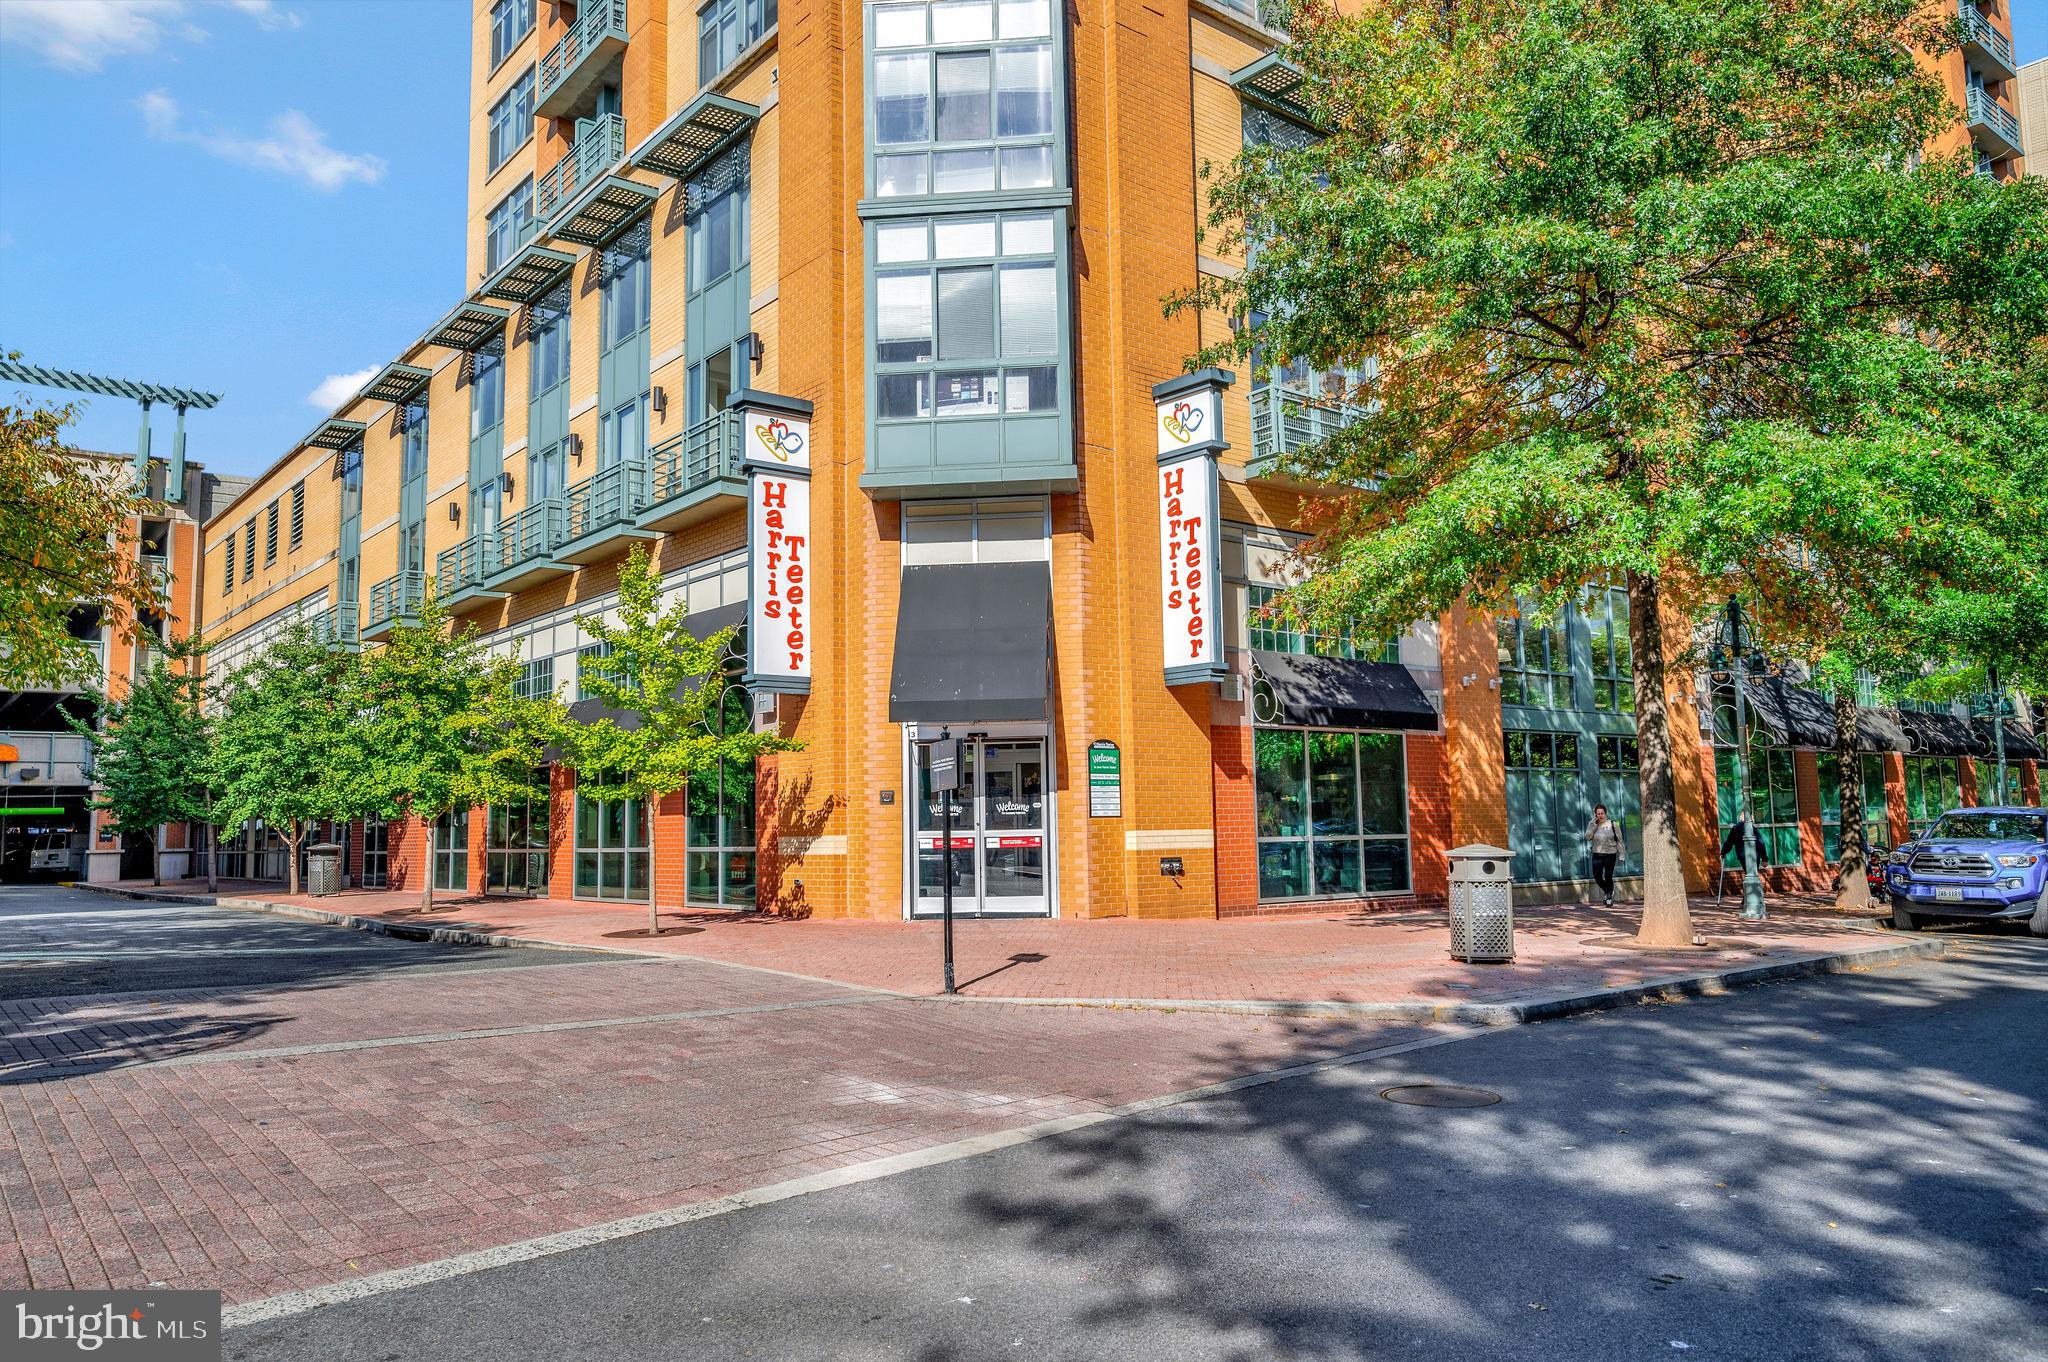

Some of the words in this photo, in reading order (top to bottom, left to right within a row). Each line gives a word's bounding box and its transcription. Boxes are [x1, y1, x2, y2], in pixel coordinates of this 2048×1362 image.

[762, 481, 787, 619] Harris
[784, 535, 805, 670] Teeter
[1163, 467, 1184, 609] Harris
[1183, 516, 1203, 657] Teeter
[928, 803, 963, 814] Welme
[995, 801, 1030, 812] Welcome
[1092, 752, 1117, 764] Welcome
